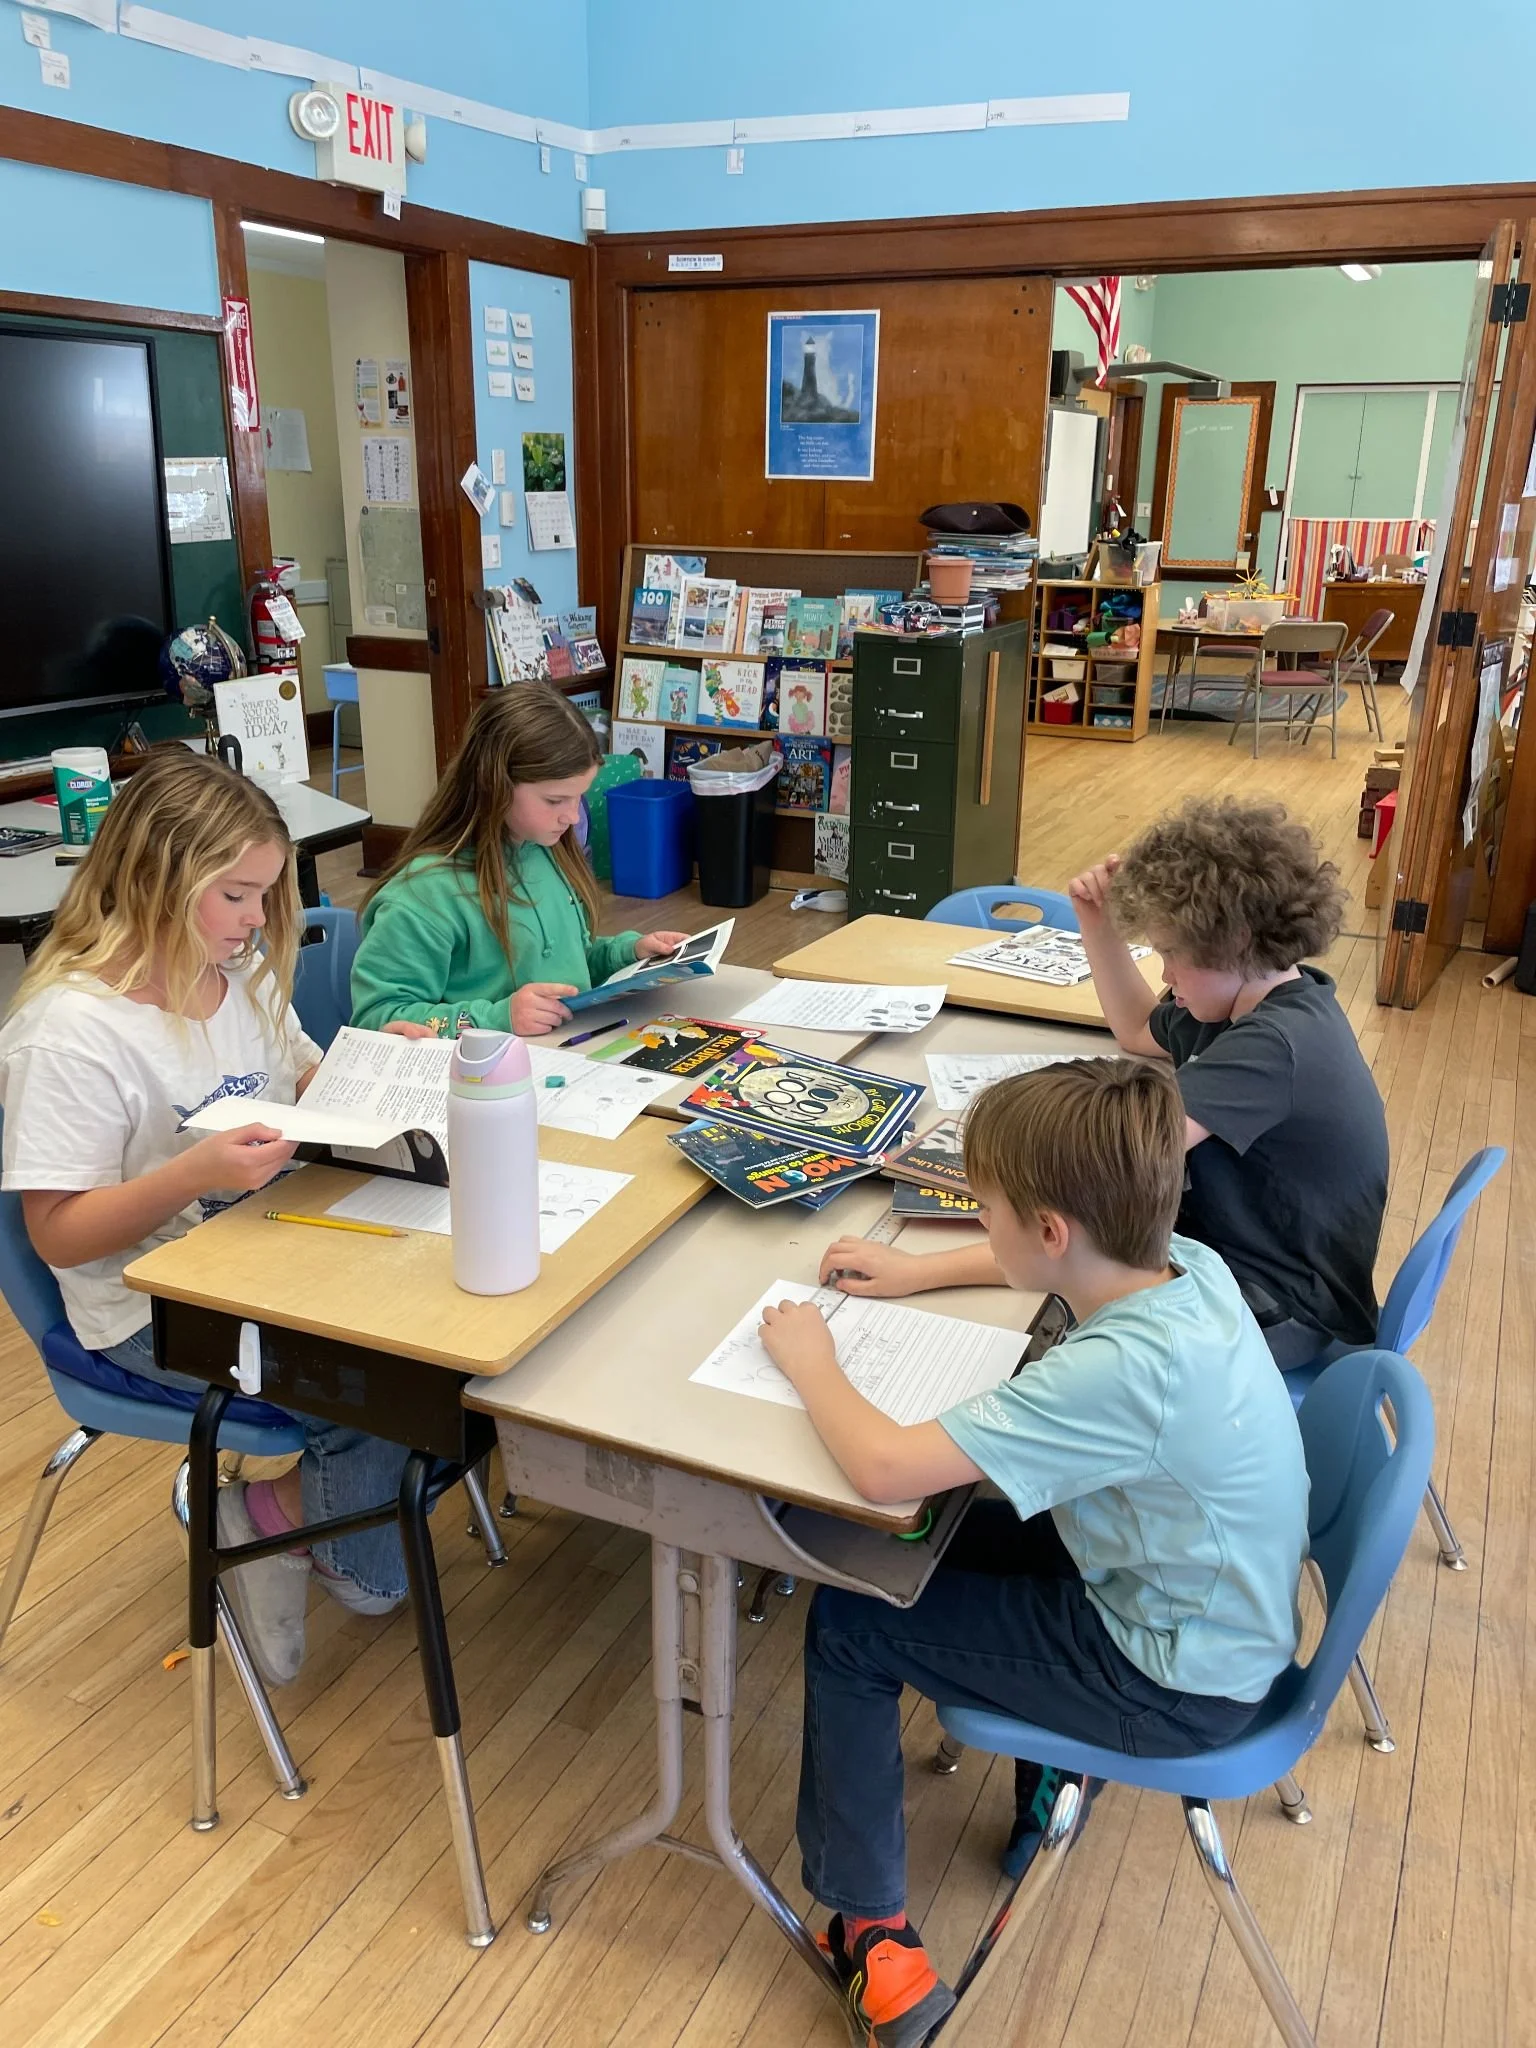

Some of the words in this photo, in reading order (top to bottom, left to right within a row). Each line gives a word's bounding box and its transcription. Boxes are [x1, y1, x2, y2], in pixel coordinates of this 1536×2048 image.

[346, 92, 394, 164] EXIT
[242, 700, 265, 710] WHAT
[265, 699, 278, 707] DO
[243, 708, 262, 719] YOU
[264, 706, 279, 714] DO
[243, 716, 267, 726] WITH
[267, 714, 280, 724] AN
[245, 720, 288, 739] IDEA?
[641, 735, 656, 743] DAY
[788, 748, 816, 761] ART
[69, 780, 93, 789] CLOROX
[711, 1034, 741, 1050] BIG
[670, 1046, 719, 1074] DIPPER
[753, 1070, 815, 1117] BOOK
[788, 1075, 851, 1128] MOON
[831, 1112, 881, 1136] GIBBONS
[788, 1160, 804, 1168] to
[907, 1156, 933, 1169] Like
[746, 1164, 789, 1181] Change
[940, 1199, 980, 1211] the
[982, 1393, 1016, 1431] ebok
